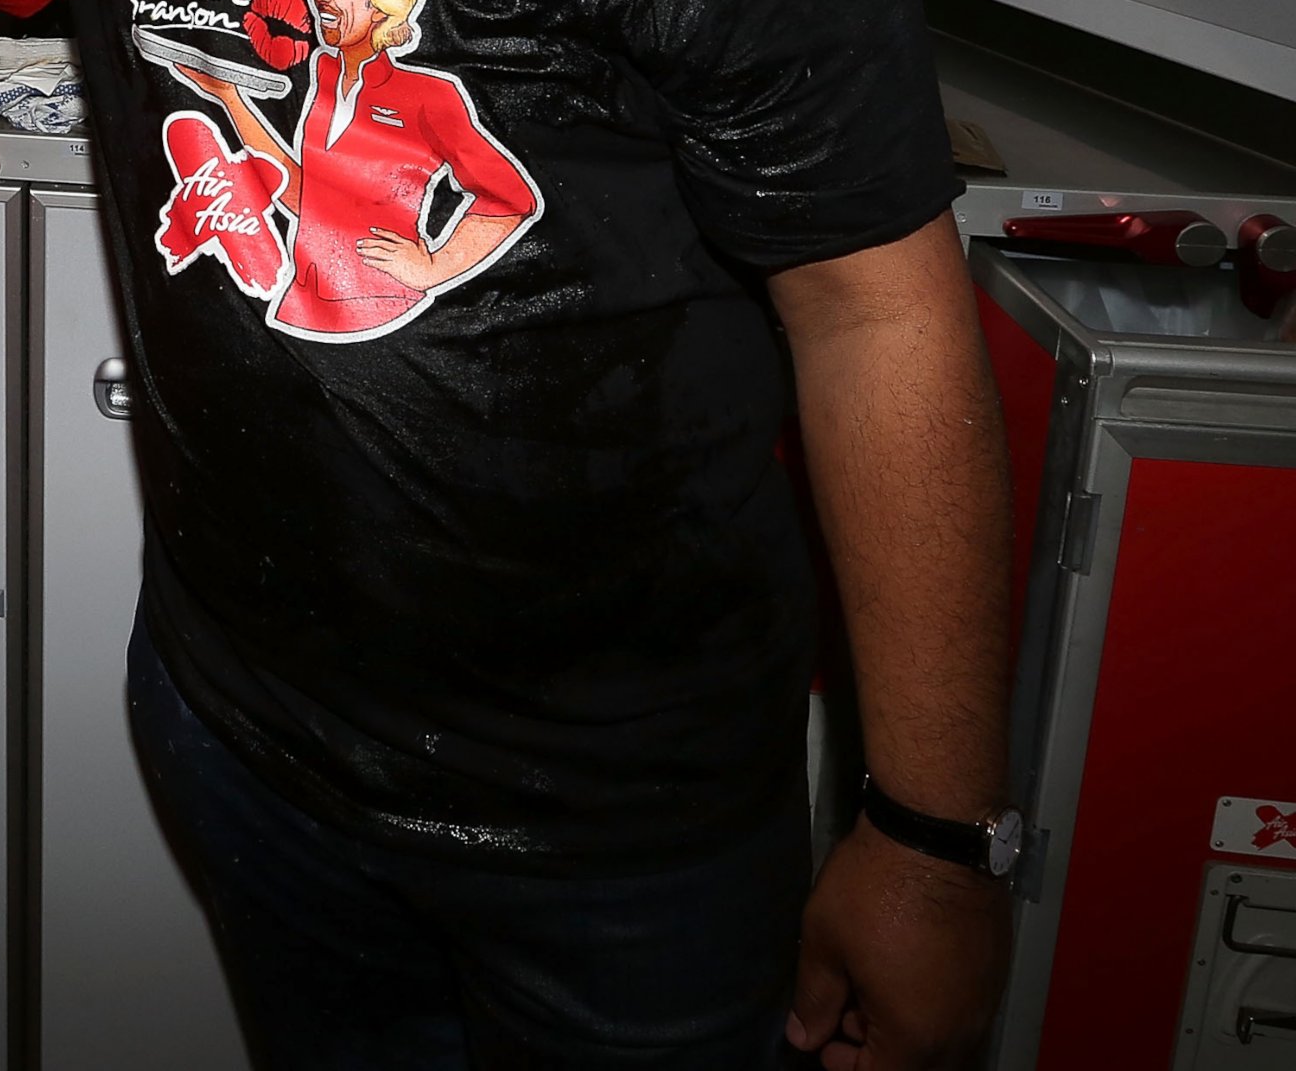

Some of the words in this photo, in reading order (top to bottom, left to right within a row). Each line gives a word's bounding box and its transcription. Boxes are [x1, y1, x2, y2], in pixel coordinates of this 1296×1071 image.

[70, 144, 84, 152] 114
[182, 156, 234, 201] Air
[1033, 195, 1051, 204] 116
[194, 191, 261, 236] Asia
